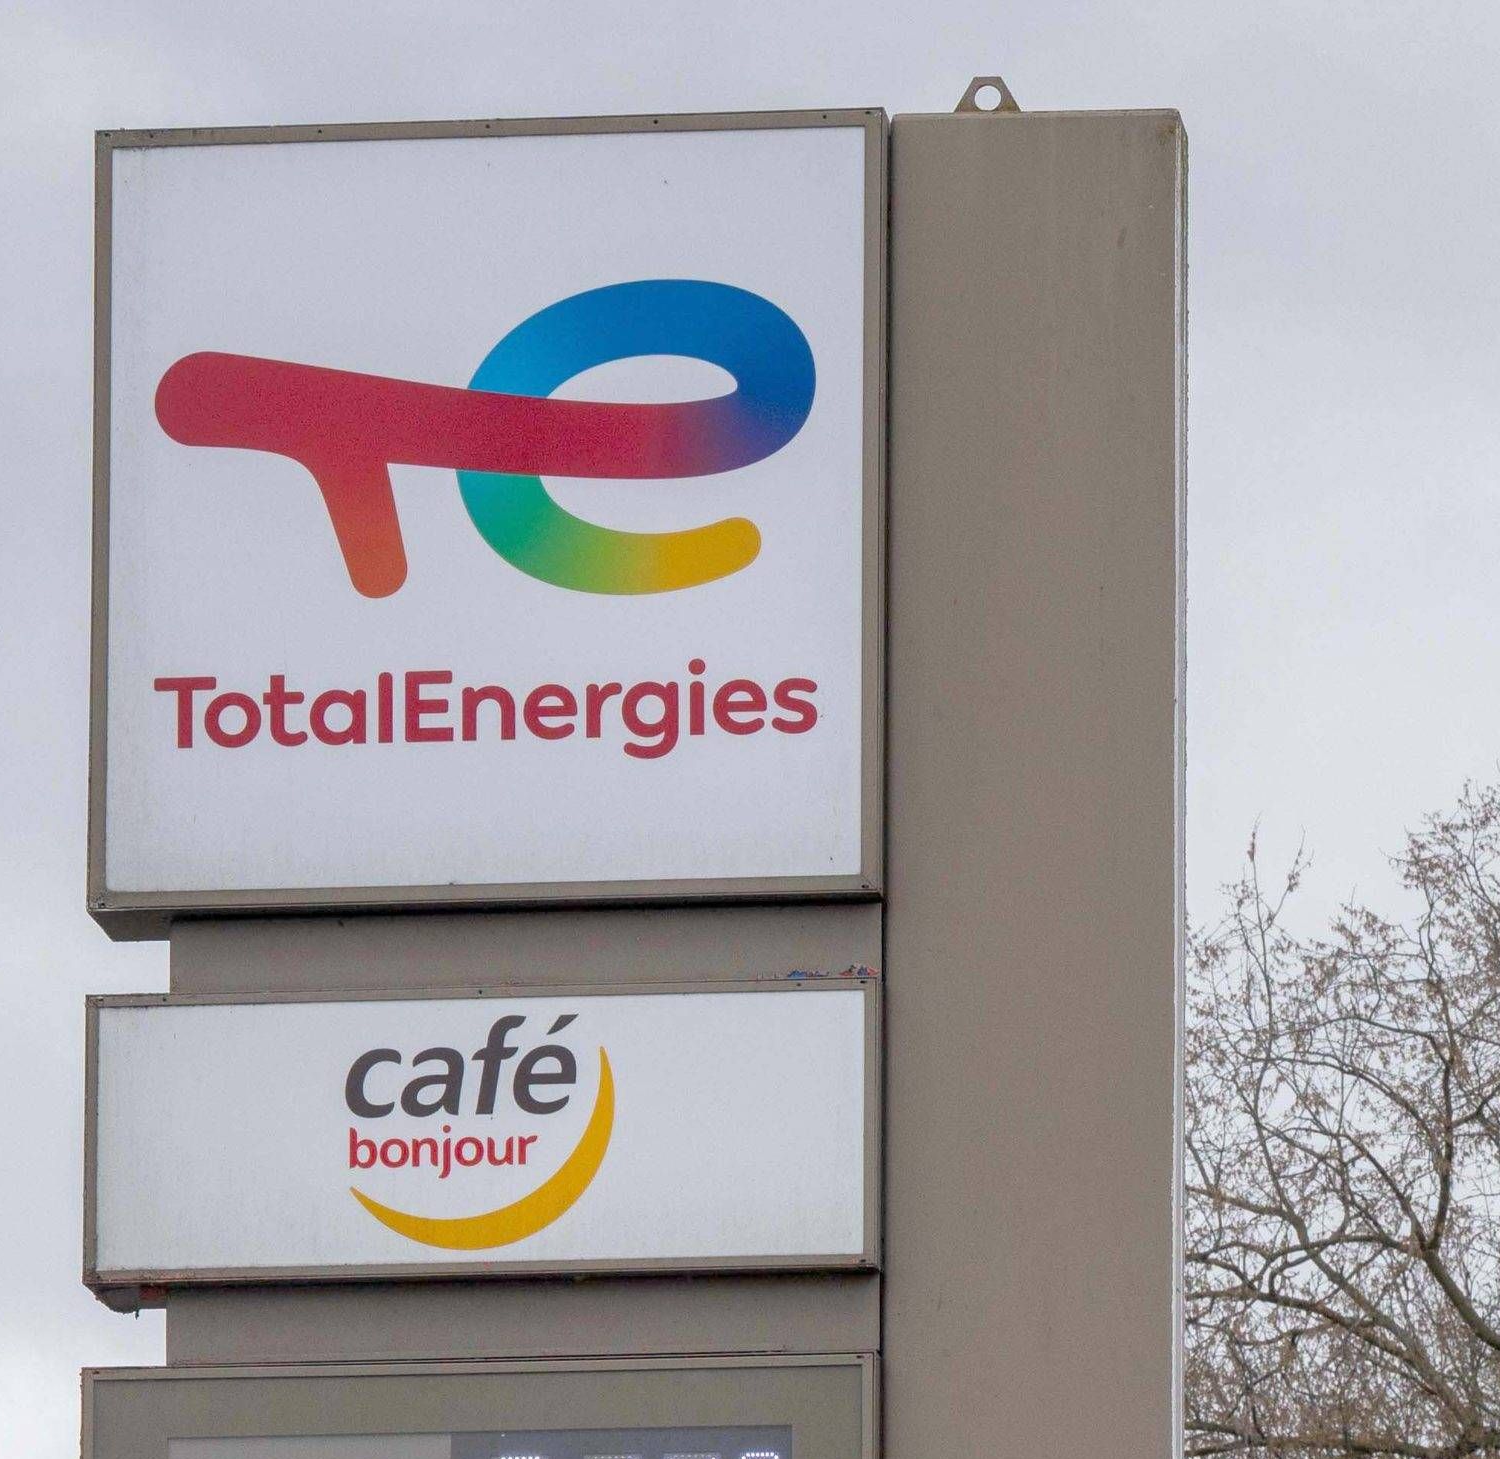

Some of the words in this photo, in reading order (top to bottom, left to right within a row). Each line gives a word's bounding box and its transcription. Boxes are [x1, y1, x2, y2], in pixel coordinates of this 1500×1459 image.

[153, 660, 819, 759] TotalEnergies
[345, 1014, 579, 1118] café
[349, 1126, 538, 1179] bonjour
